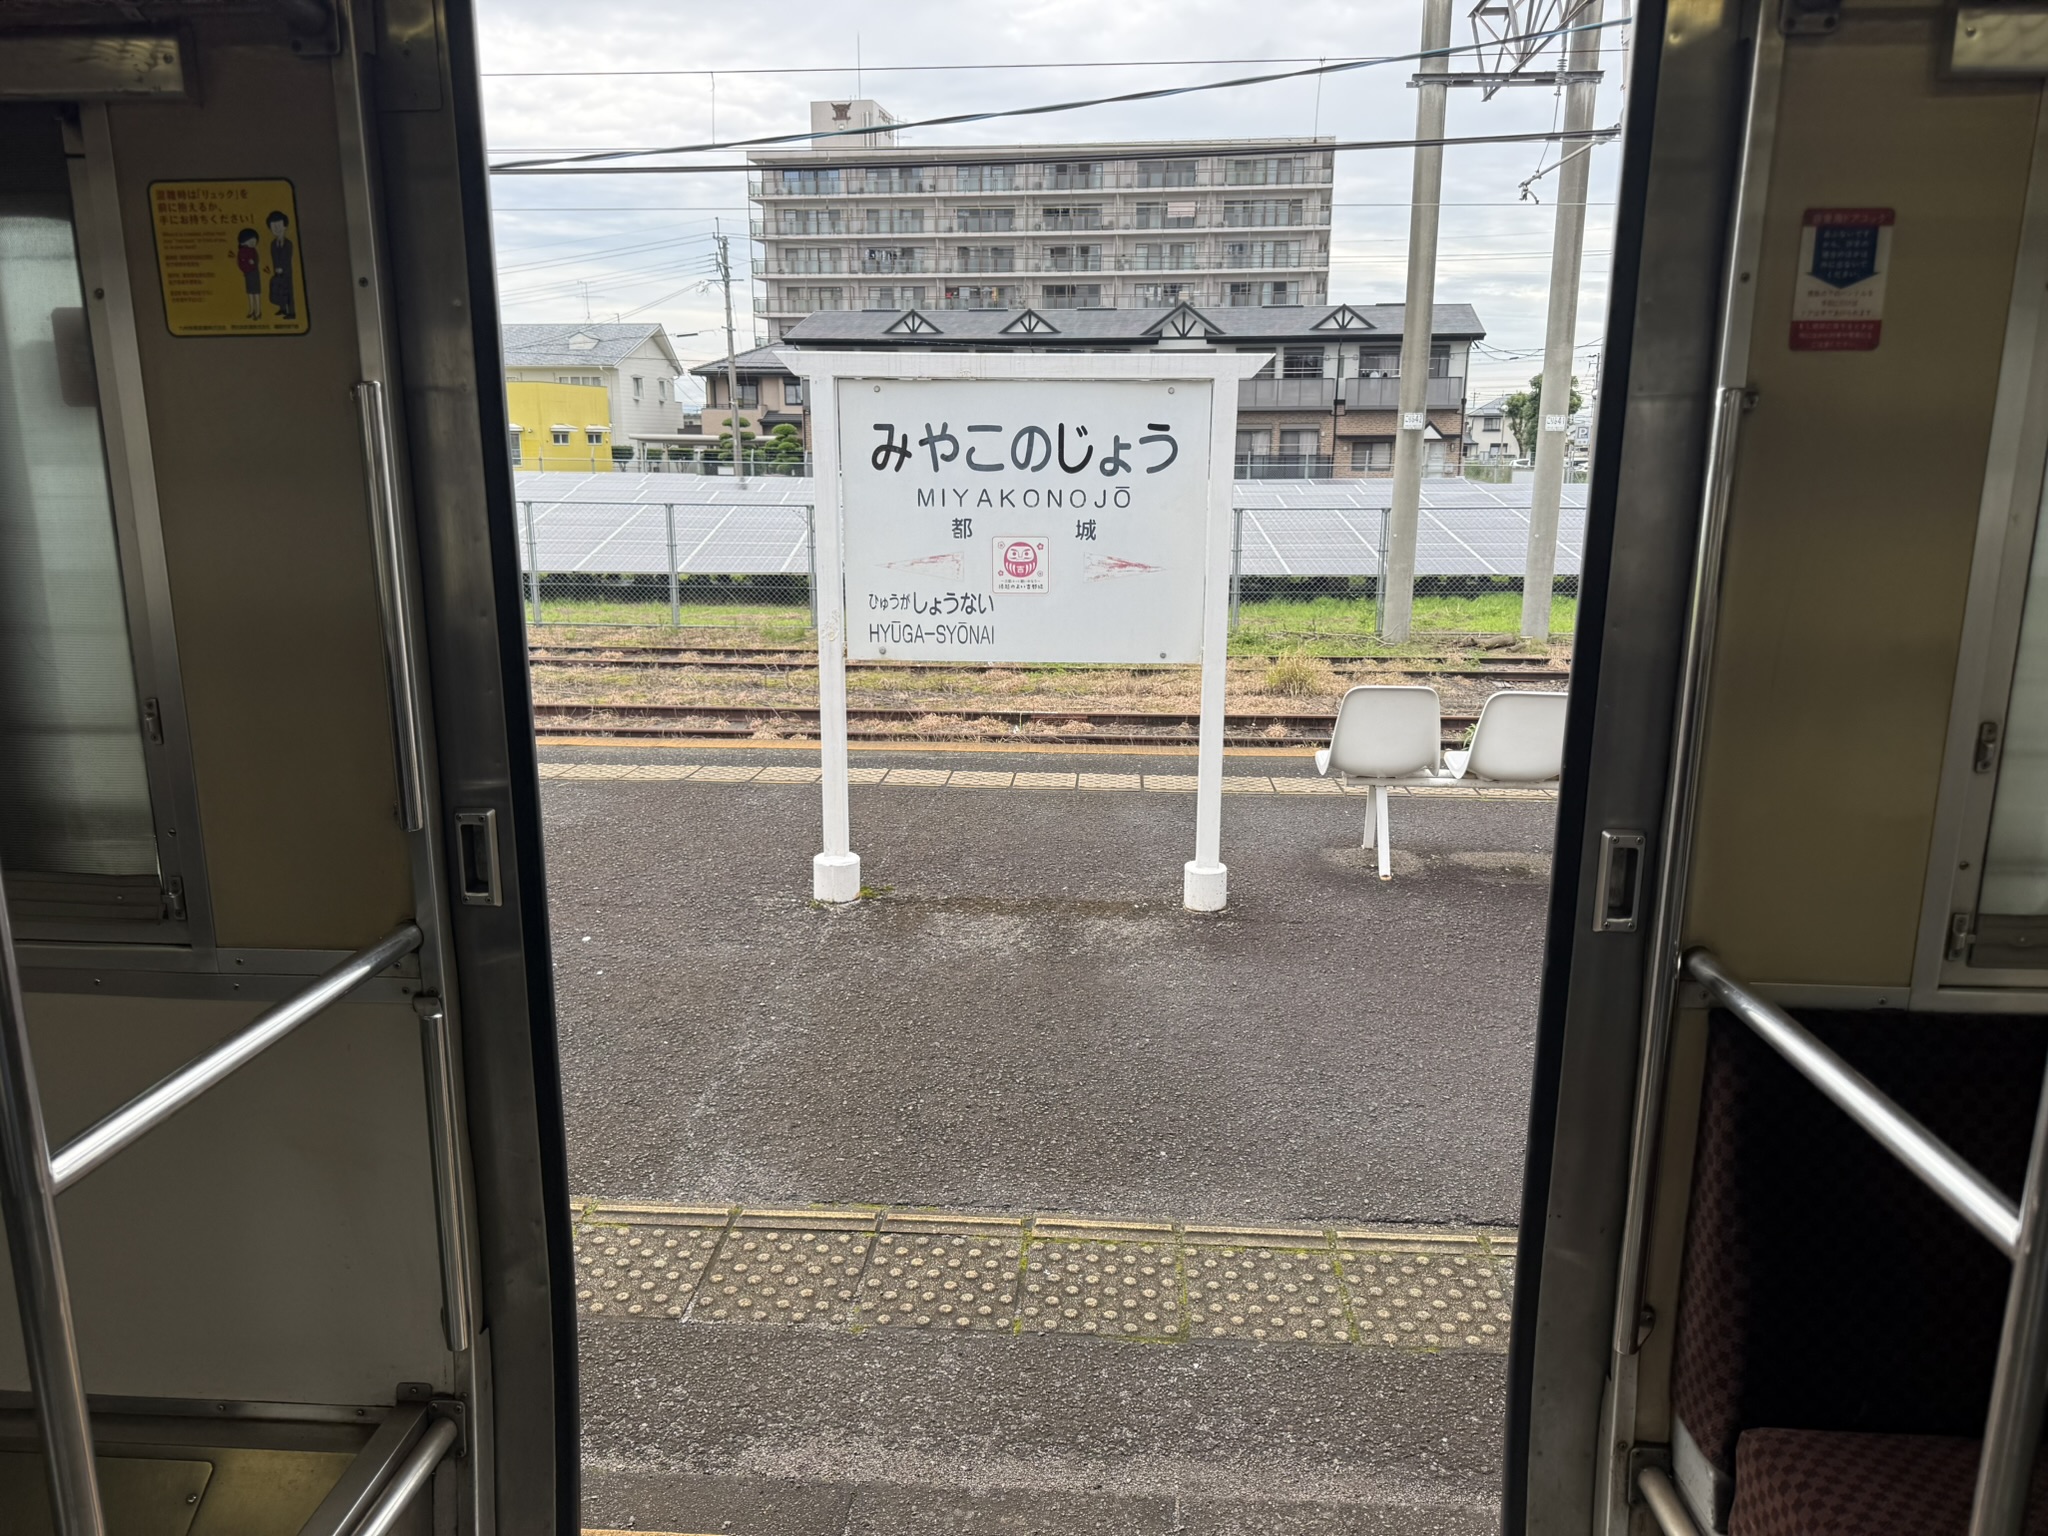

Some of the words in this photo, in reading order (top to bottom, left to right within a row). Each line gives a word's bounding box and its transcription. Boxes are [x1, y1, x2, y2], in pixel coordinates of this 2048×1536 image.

[872, 422, 1178, 476] みやこのじょう
[917, 486, 1131, 509] MIYAKONOJŌ
[952, 518, 973, 539] 都
[1075, 519, 1097, 541] 城
[868, 592, 994, 615] ひゅうがしょうない
